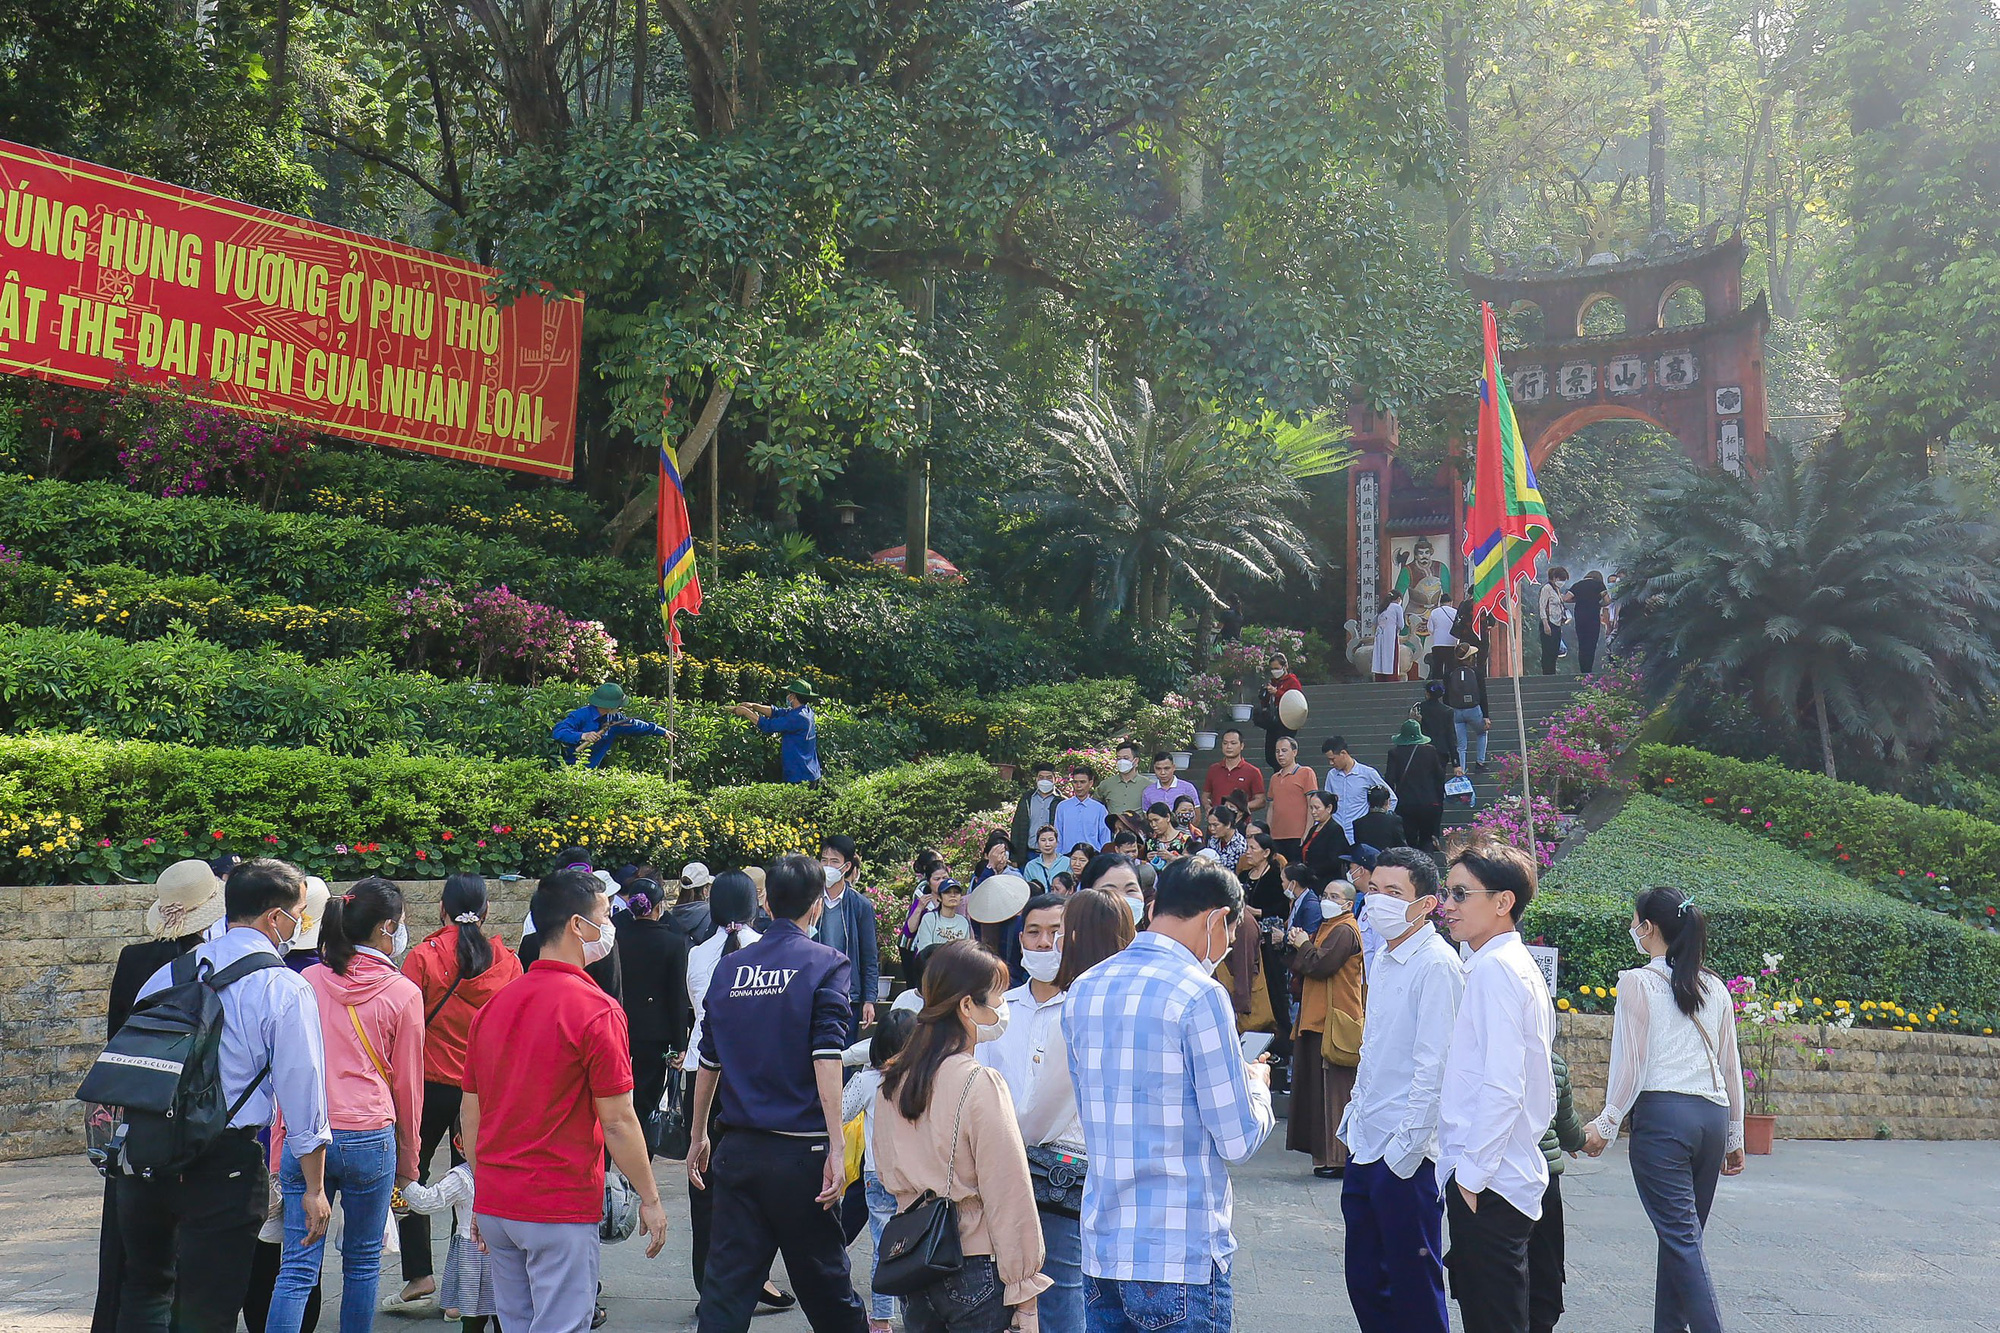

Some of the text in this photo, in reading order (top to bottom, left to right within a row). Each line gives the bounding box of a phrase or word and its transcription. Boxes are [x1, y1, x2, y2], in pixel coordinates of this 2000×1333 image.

[0, 179, 500, 367] ÚNG HÙNG VƯƠNG Ở PHÚ THỌ
[58, 283, 134, 362] THỂ
[137, 311, 202, 384] ĐẠI
[210, 325, 296, 402] DIỆN
[303, 330, 370, 411] CỦA
[379, 363, 470, 430] NHÂN
[477, 384, 543, 453] LOẠI
[729, 987, 777, 998] DONNA KARAN
[731, 964, 798, 994] Dkny
